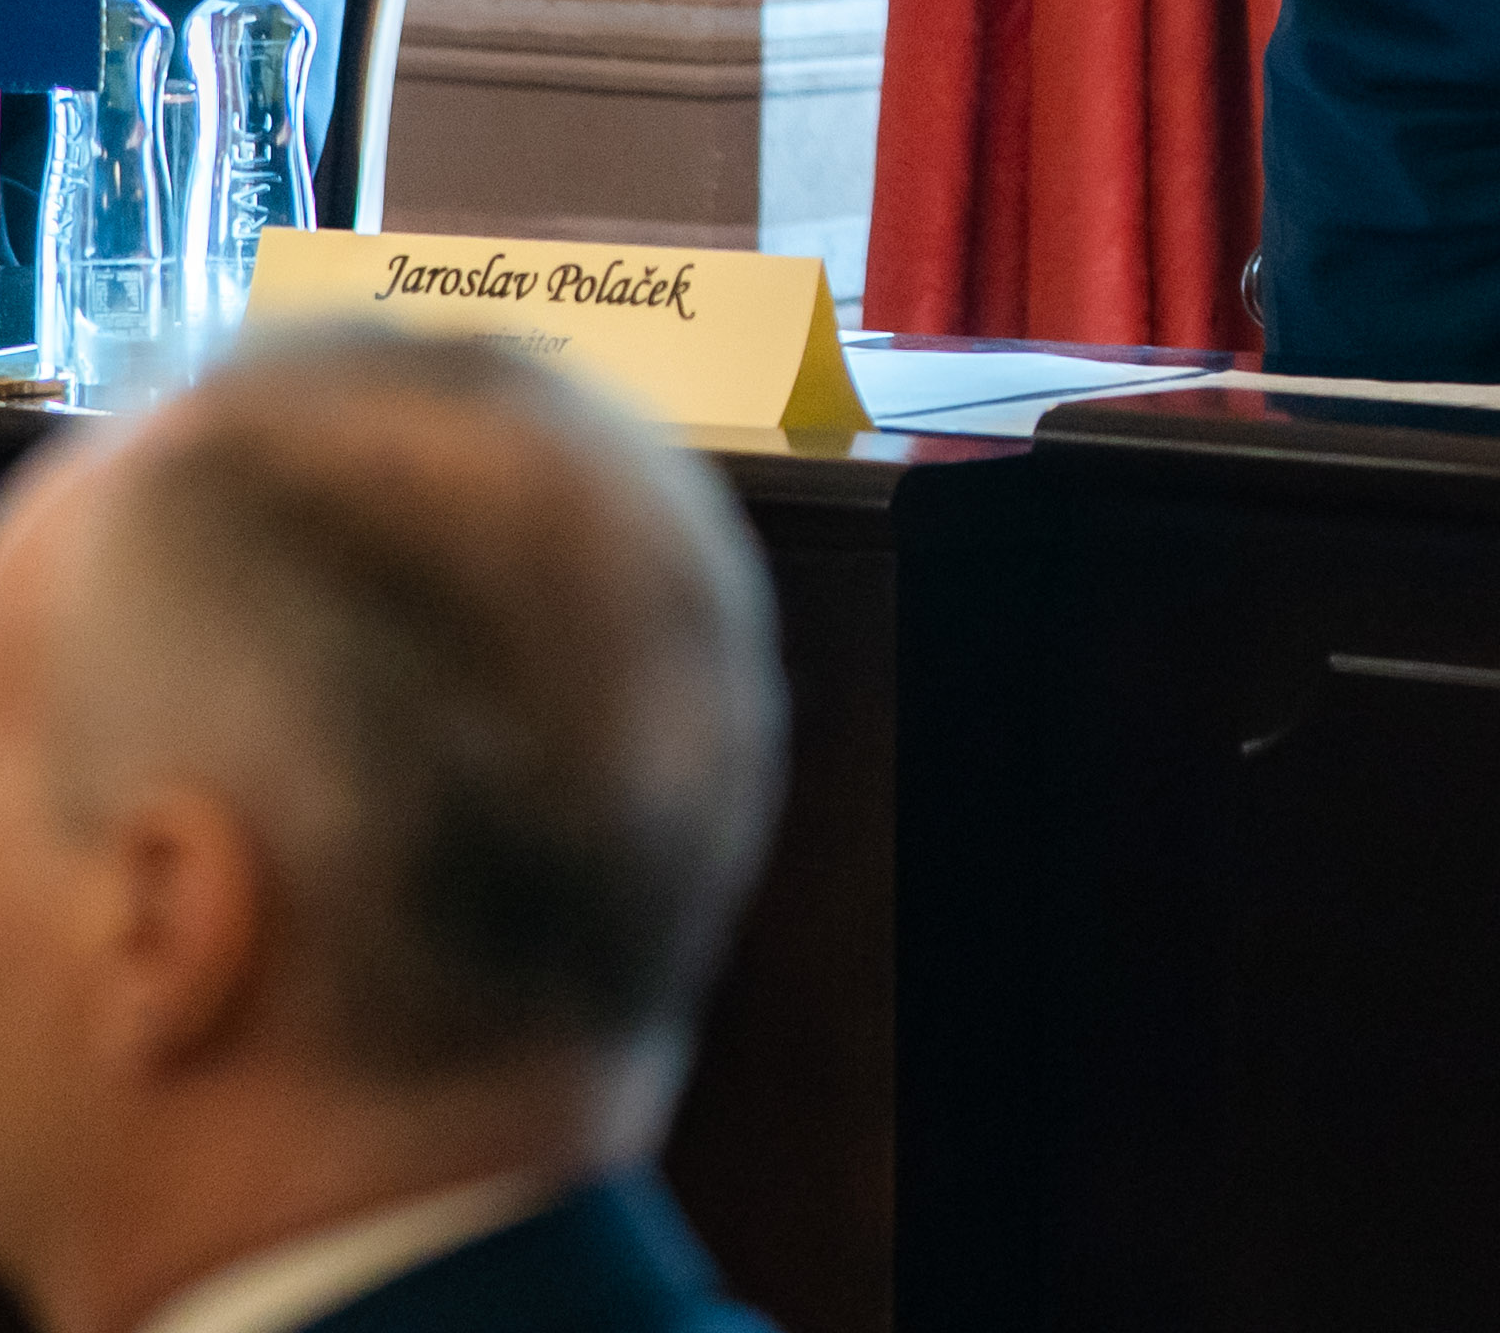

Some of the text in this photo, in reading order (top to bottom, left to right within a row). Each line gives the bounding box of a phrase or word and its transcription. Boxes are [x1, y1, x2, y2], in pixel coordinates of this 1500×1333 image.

[232, 112, 282, 238] RAJEC
[374, 252, 696, 321] Jaroslav Polaček
[472, 326, 574, 354] átor
